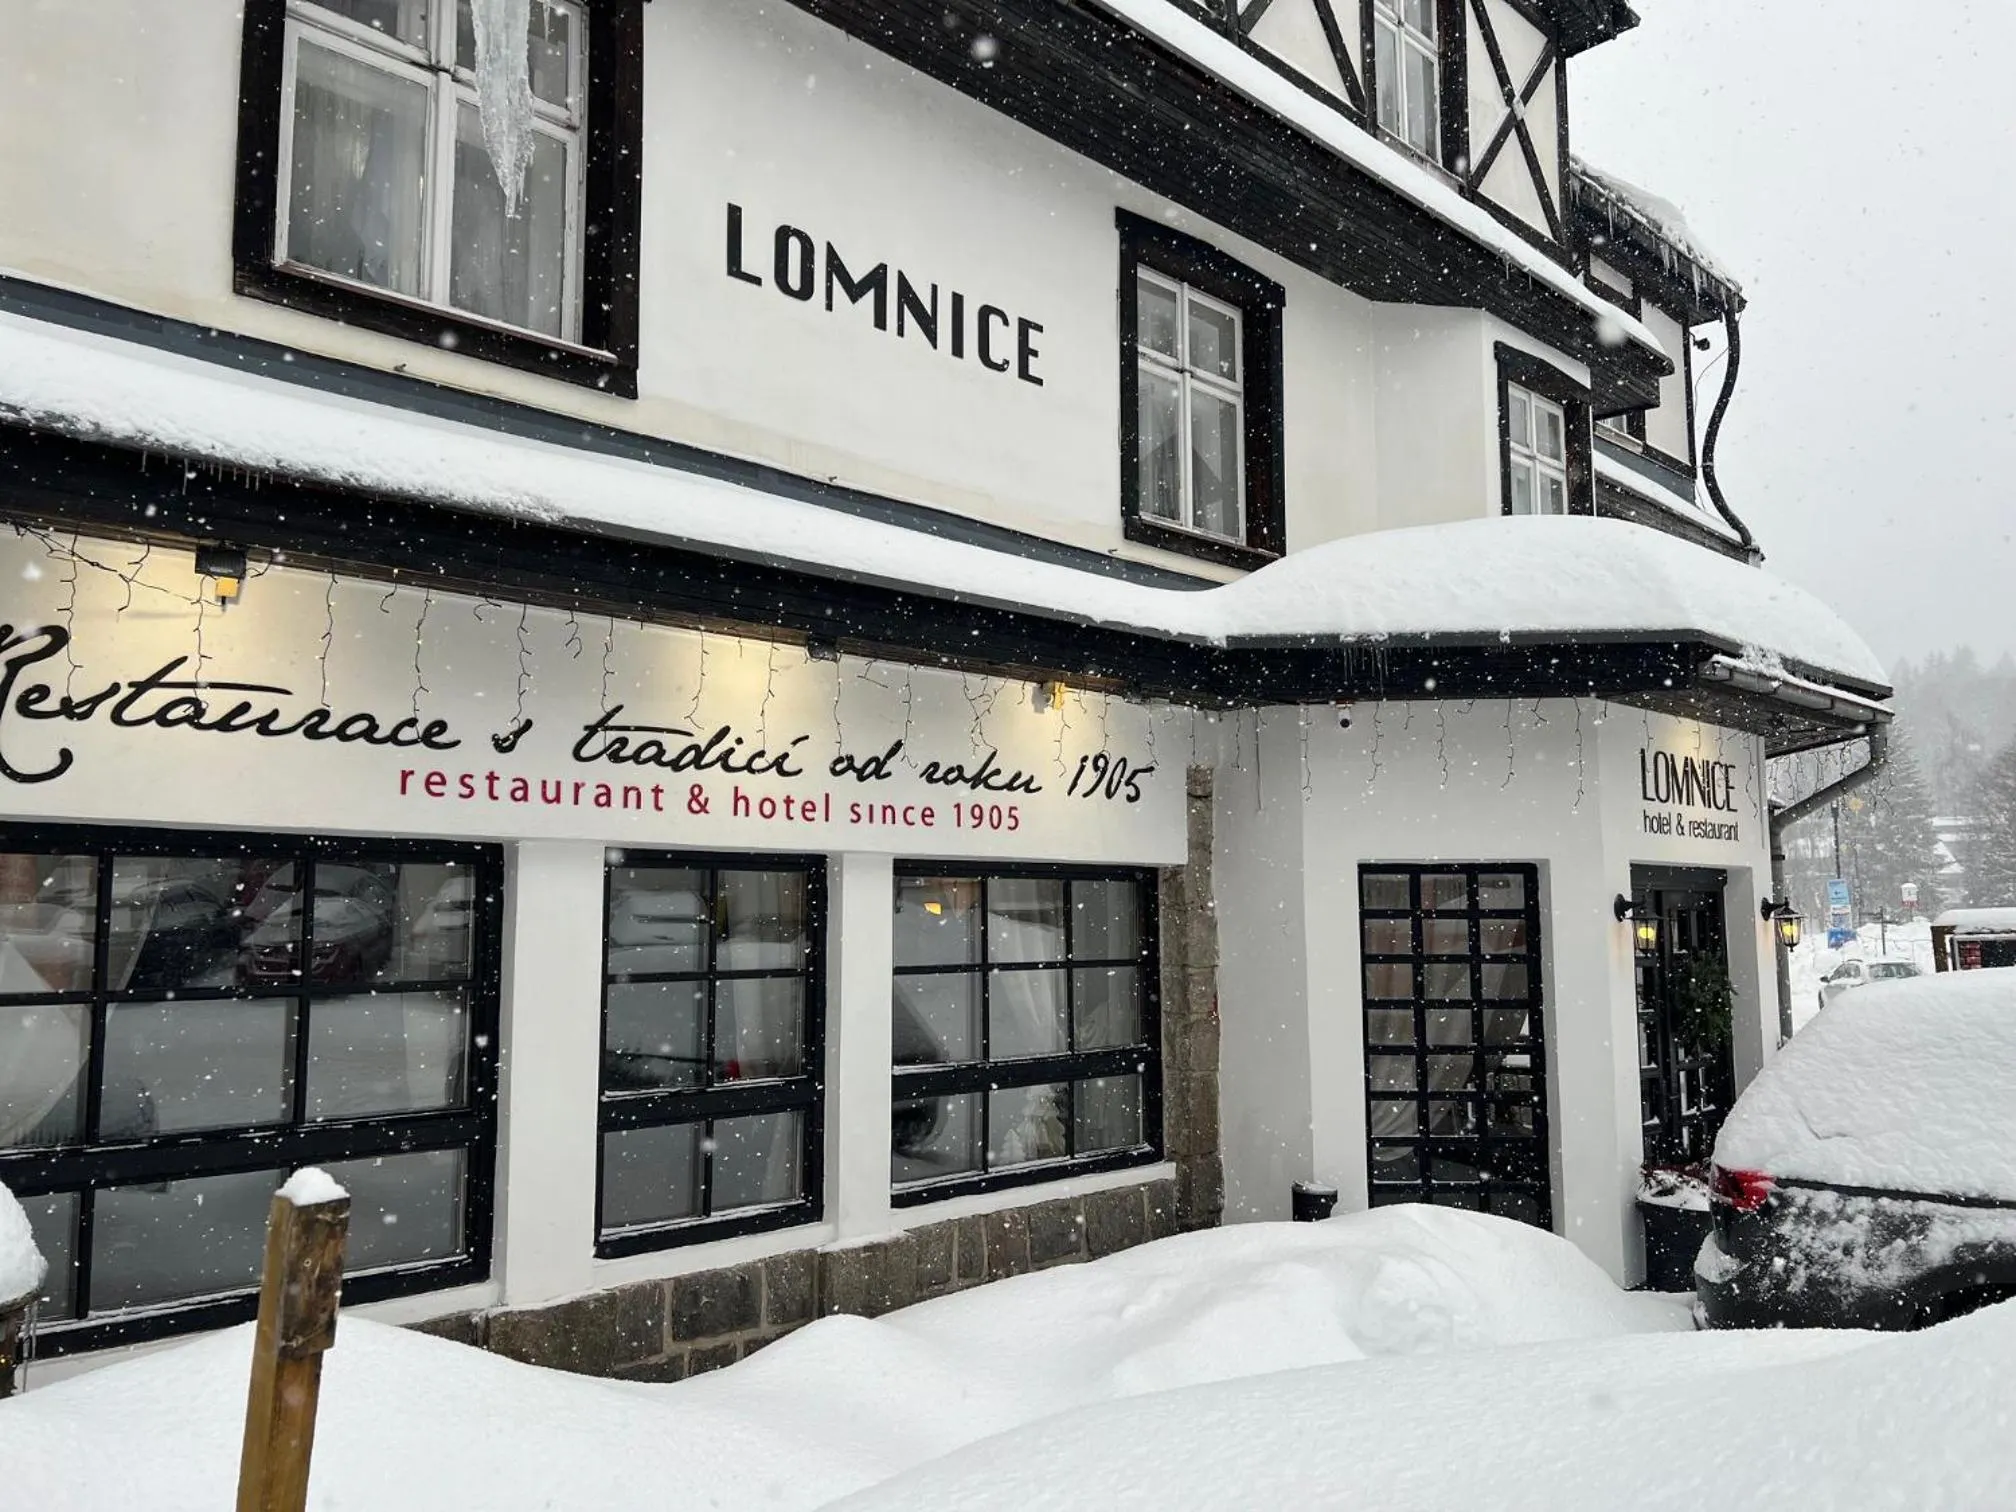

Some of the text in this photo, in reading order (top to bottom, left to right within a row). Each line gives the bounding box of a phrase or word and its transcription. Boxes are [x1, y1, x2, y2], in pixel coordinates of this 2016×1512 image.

[727, 202, 1044, 386] LOMNICE
[572, 704, 810, 777] tradicí
[829, 739, 904, 783] od
[919, 751, 1042, 794] roku
[1066, 754, 1156, 803] 1905
[1640, 747, 1739, 813] LOMNICE
[399, 768, 1021, 831] restaurant & hotel since 1905
[1643, 808, 1740, 842] hotel & restaurant
